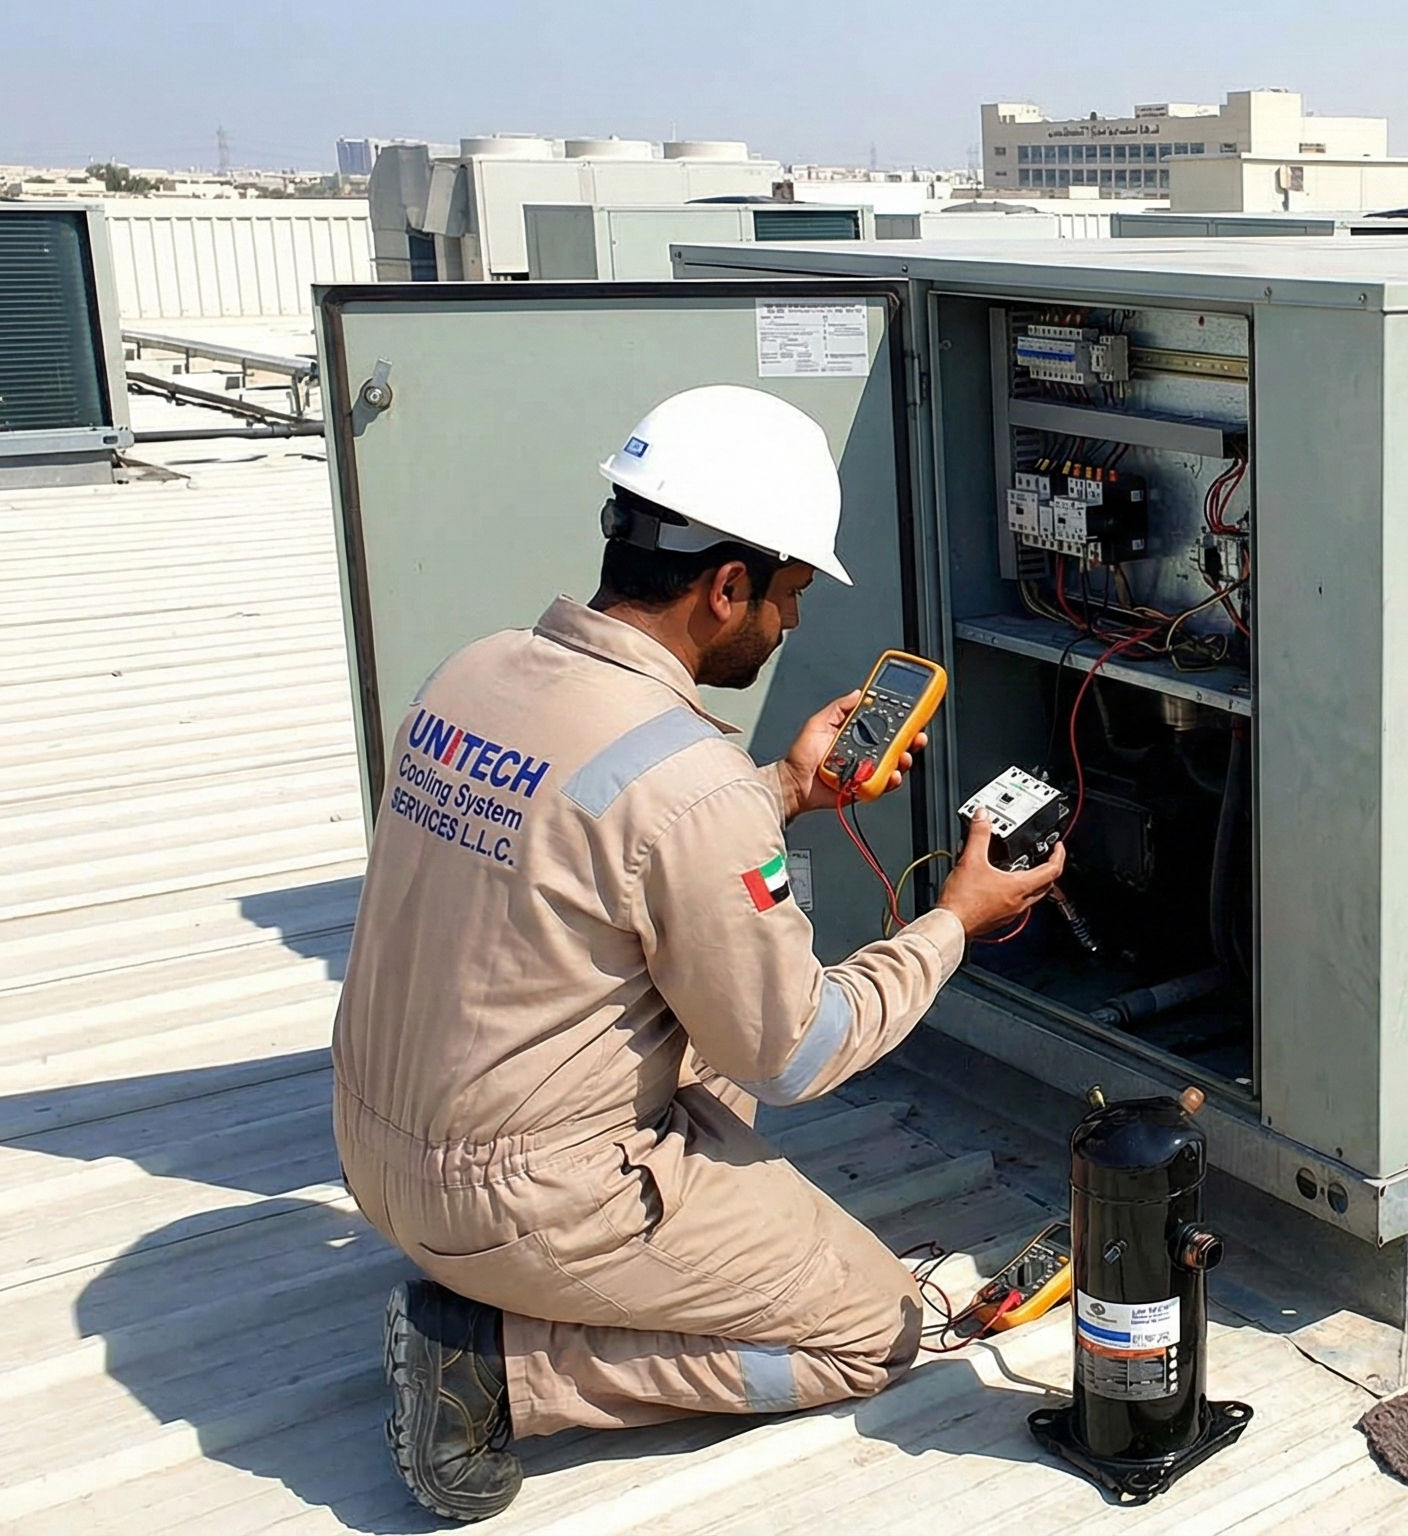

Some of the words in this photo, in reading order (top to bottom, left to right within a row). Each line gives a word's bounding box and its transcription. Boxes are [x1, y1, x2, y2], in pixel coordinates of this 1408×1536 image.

[399, 753, 454, 807] Cooling
[454, 783, 523, 831] System
[408, 708, 551, 799] UNITECH
[391, 786, 459, 841] SERVICES
[459, 822, 514, 866] L.L.C.
